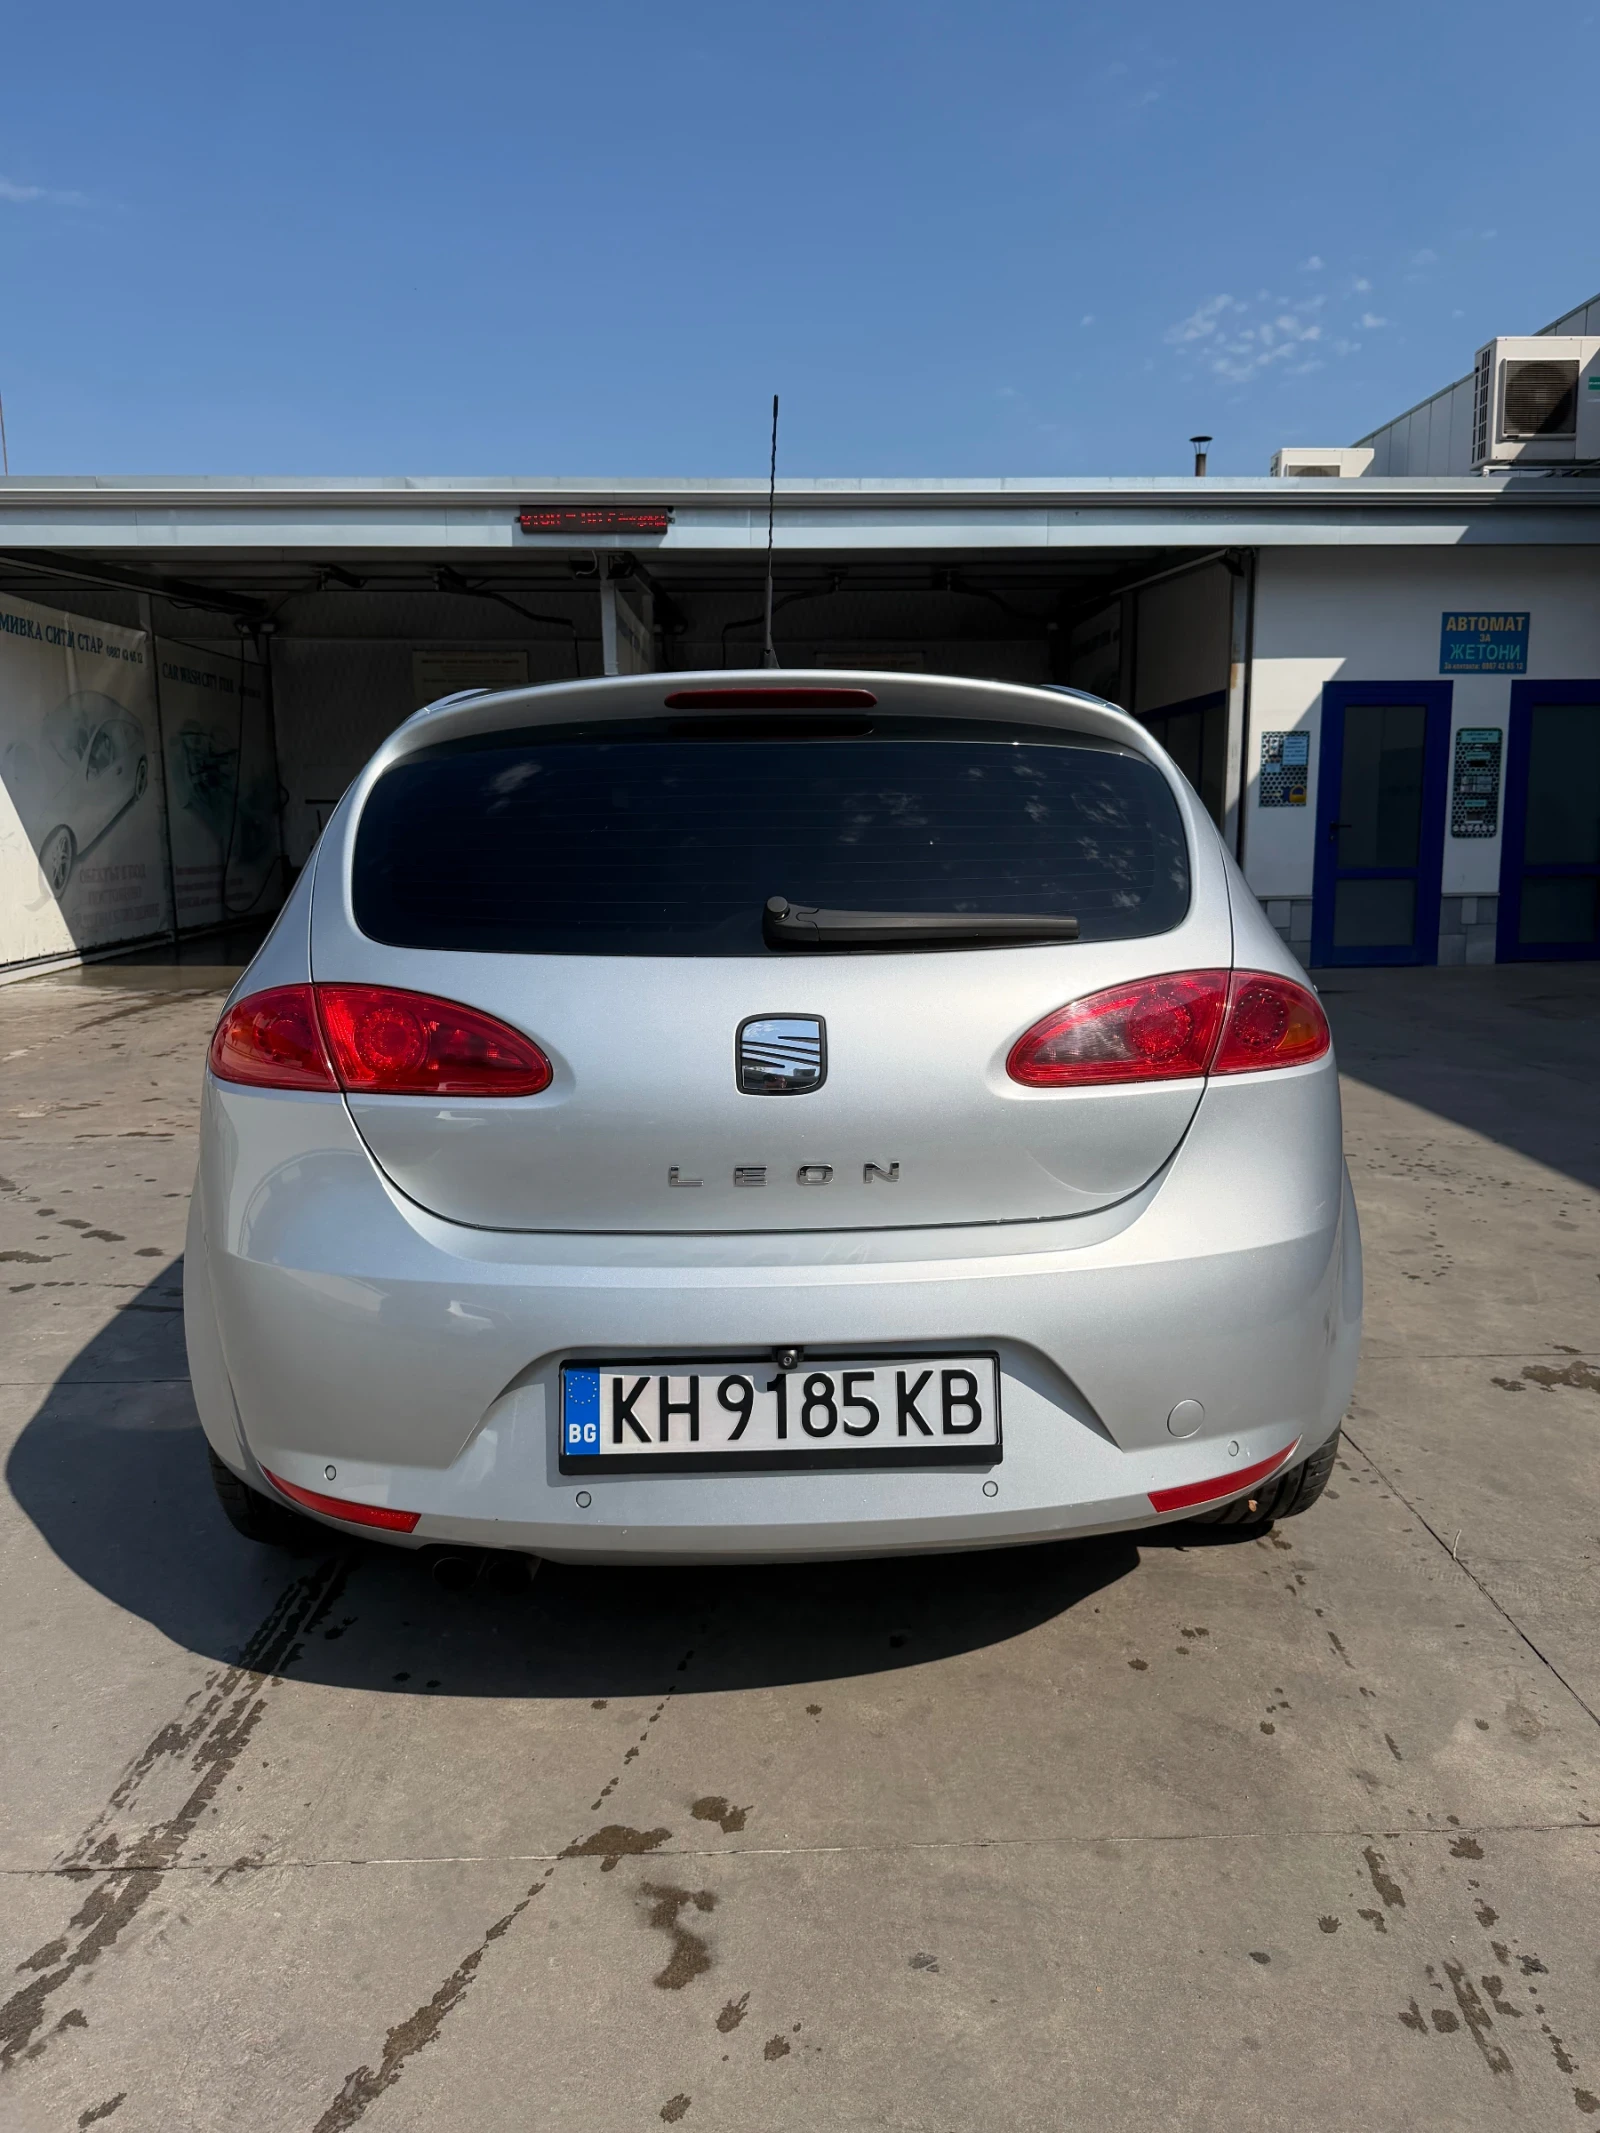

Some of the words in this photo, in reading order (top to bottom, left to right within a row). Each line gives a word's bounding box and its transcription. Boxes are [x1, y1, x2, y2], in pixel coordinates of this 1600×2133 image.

[1445, 616, 1526, 632] АВТОМАТ
[45, 625, 75, 649] СИТИ
[78, 633, 103, 654] СТАР
[1479, 633, 1491, 642] ЗА
[1449, 644, 1520, 660] ЖЕТОНИ
[162, 662, 179, 681] CAR
[179, 666, 201, 686] WASH
[1516, 662, 1523, 670] 12
[668, 1160, 901, 1187] LEON
[612, 1375, 700, 1444] KH
[716, 1371, 881, 1441] 9185
[895, 1368, 983, 1437] KB
[568, 1423, 597, 1444] BG
